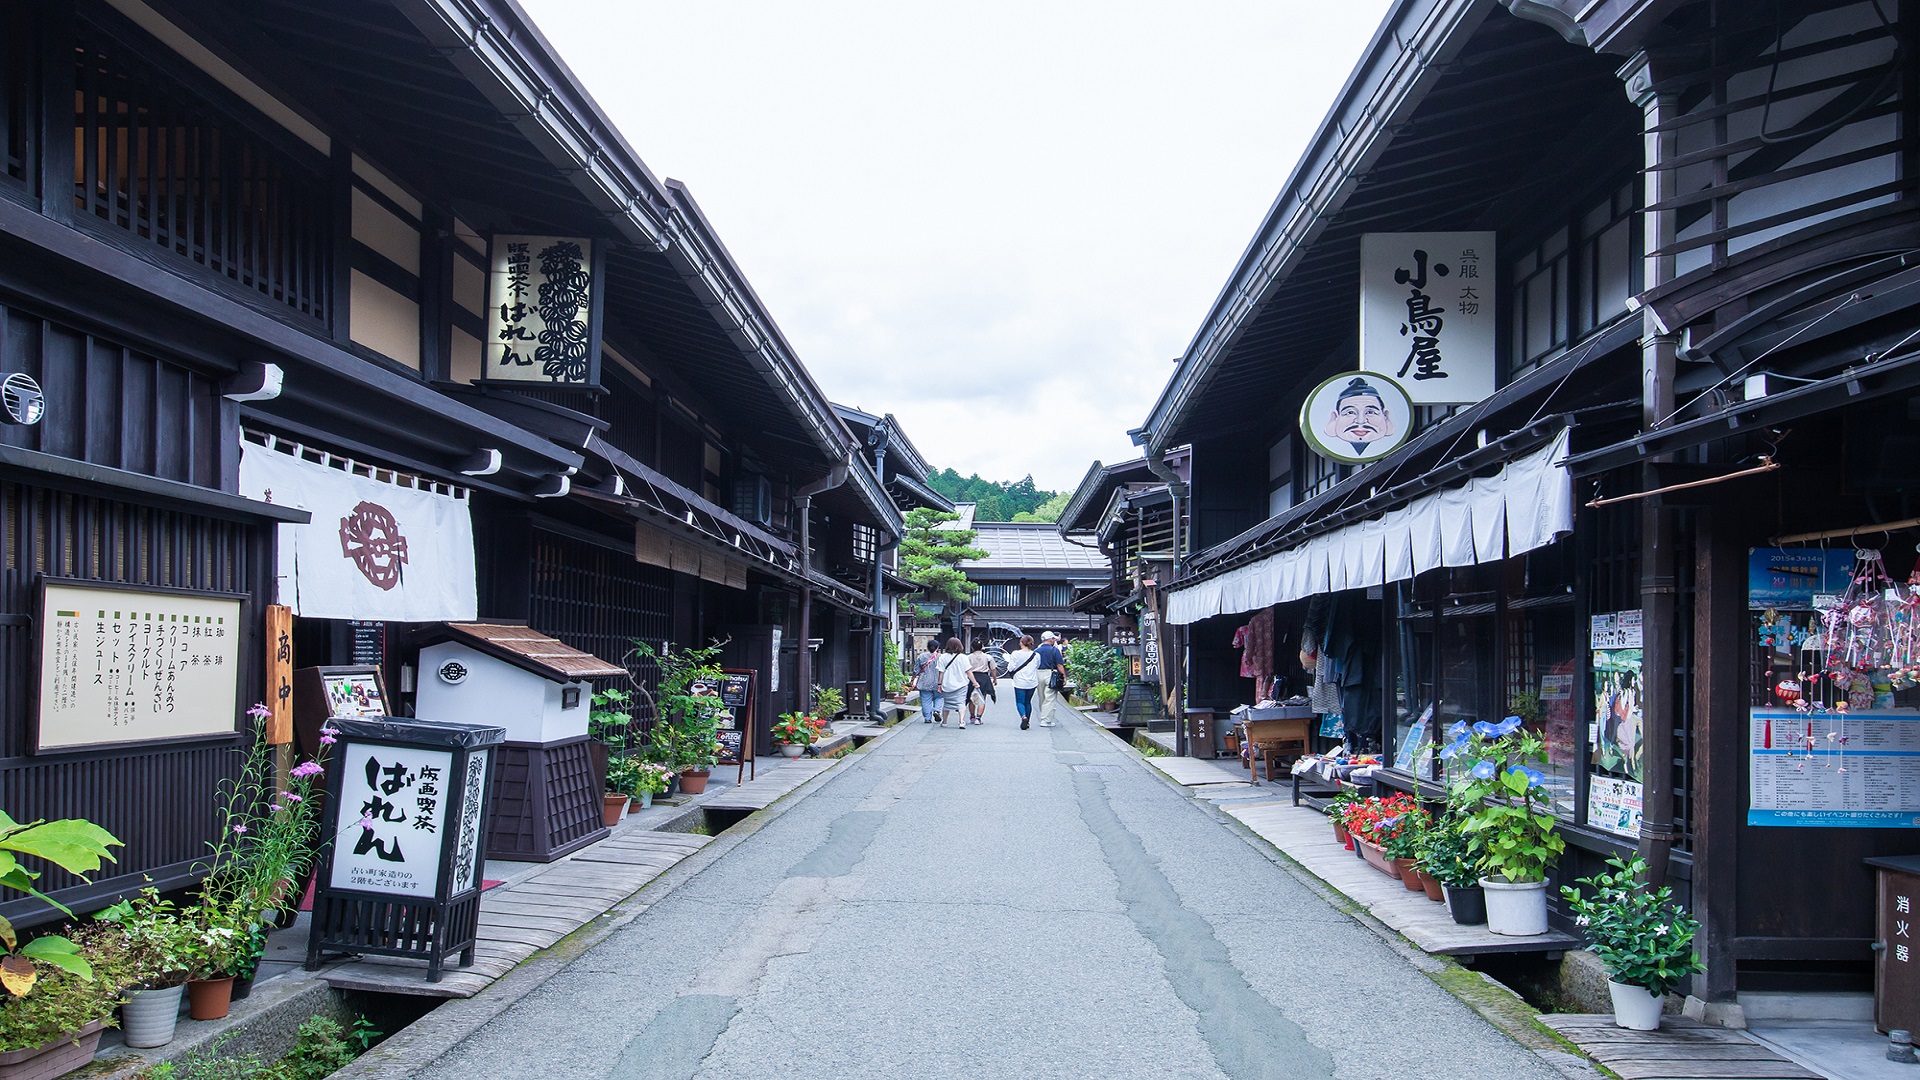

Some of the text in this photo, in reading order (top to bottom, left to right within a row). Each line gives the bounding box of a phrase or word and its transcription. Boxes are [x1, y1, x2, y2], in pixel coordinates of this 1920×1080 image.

[498, 242, 539, 366] 版画喫茶 ばれん
[1458, 249, 1479, 315] 呉服 太物
[1394, 249, 1450, 381] 小鳥屋
[93, 621, 106, 684] 生ジュース
[112, 622, 121, 663] セット
[126, 623, 138, 696] アイスクリーム
[141, 623, 152, 680] ヨーグルト
[153, 624, 165, 713] 手づくりぜんざい
[166, 625, 177, 713] クリームあんみつ
[180, 625, 189, 671] ココア
[190, 627, 201, 666] 抹茶
[202, 627, 213, 666] 紅茶
[214, 627, 225, 666] 珈琲
[352, 755, 415, 863] ばれん
[412, 764, 442, 834] 版画喫茶
[350, 876, 419, 890] 2階もございます
[351, 866, 413, 879] 古い町家造りの
[1895, 895, 1910, 963] 消火器
